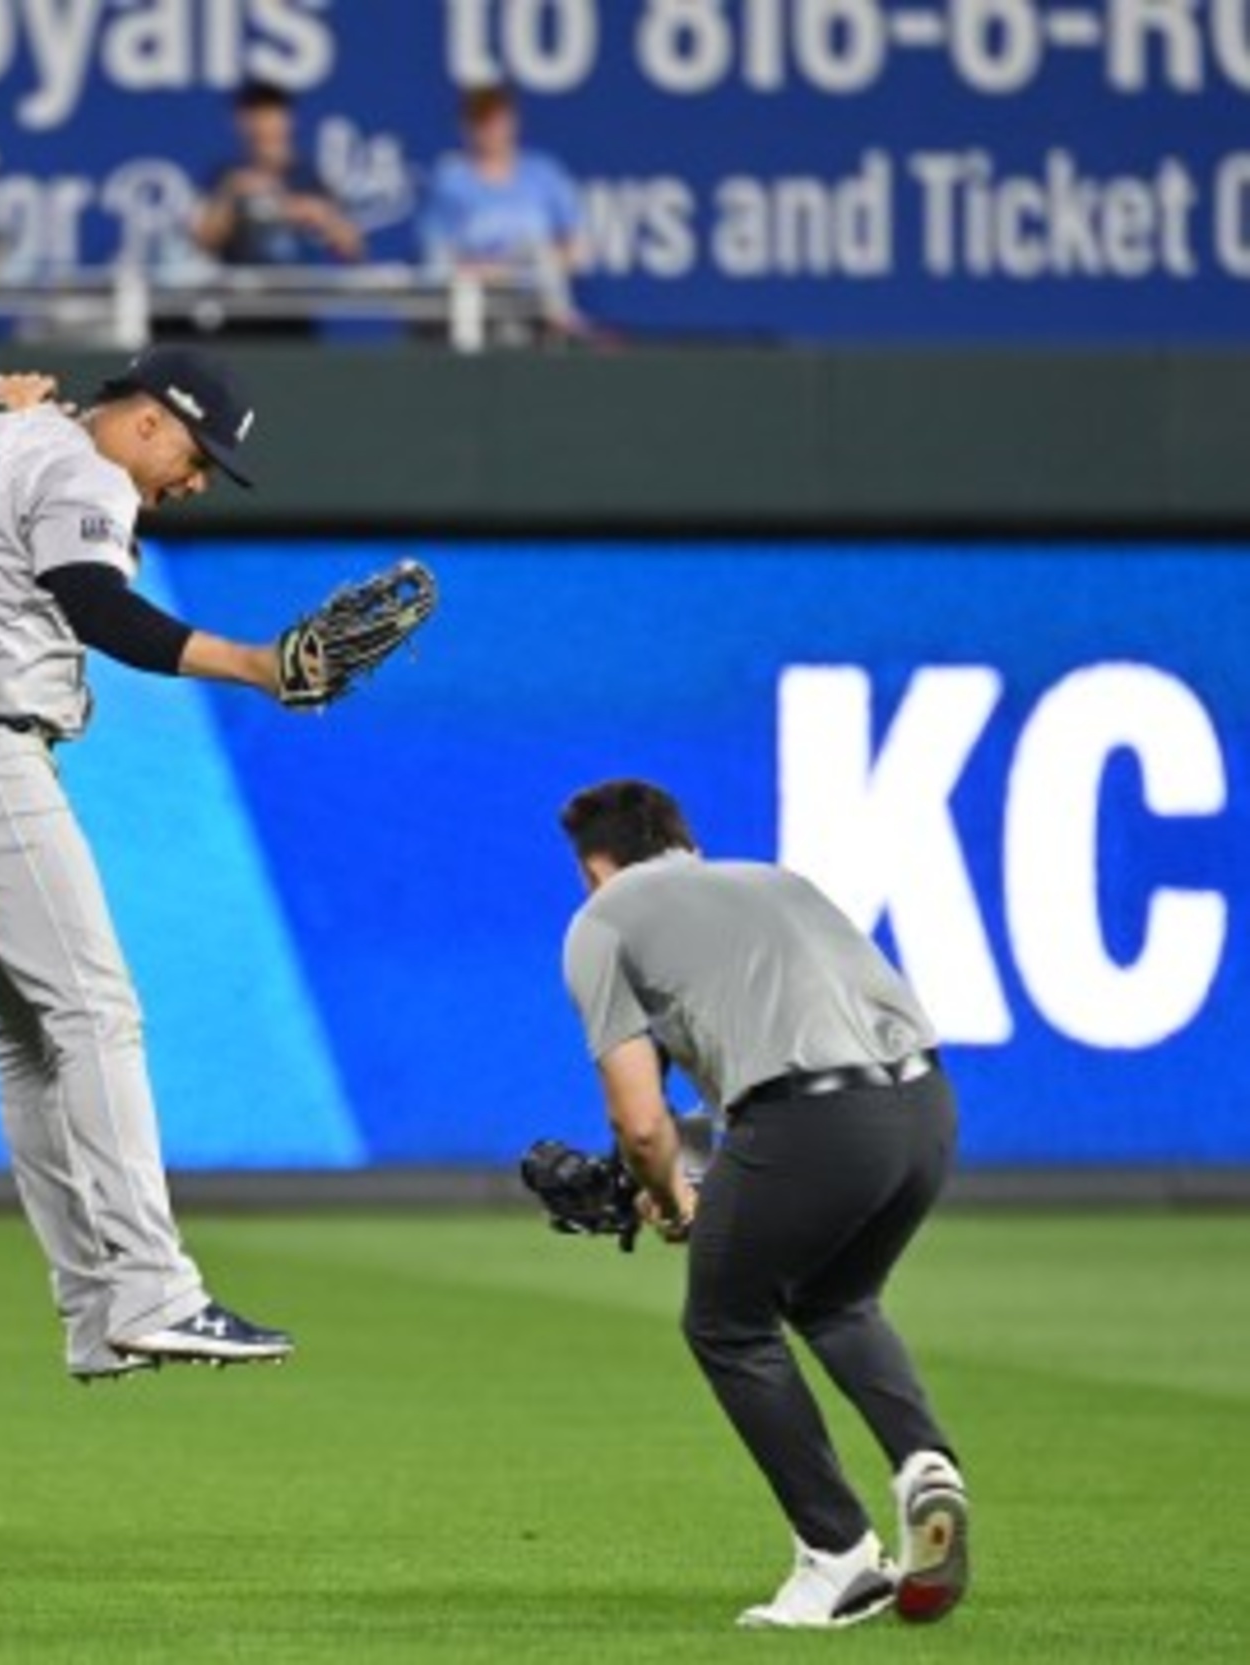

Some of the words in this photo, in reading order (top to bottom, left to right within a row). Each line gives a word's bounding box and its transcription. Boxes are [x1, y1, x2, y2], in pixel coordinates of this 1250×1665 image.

[447, 0, 600, 94] to
[634, 0, 1250, 95] 816-6-R
[585, 174, 697, 279] ws
[710, 148, 893, 279] and
[906, 148, 1198, 280] Ticket
[777, 661, 1228, 1050] KC
